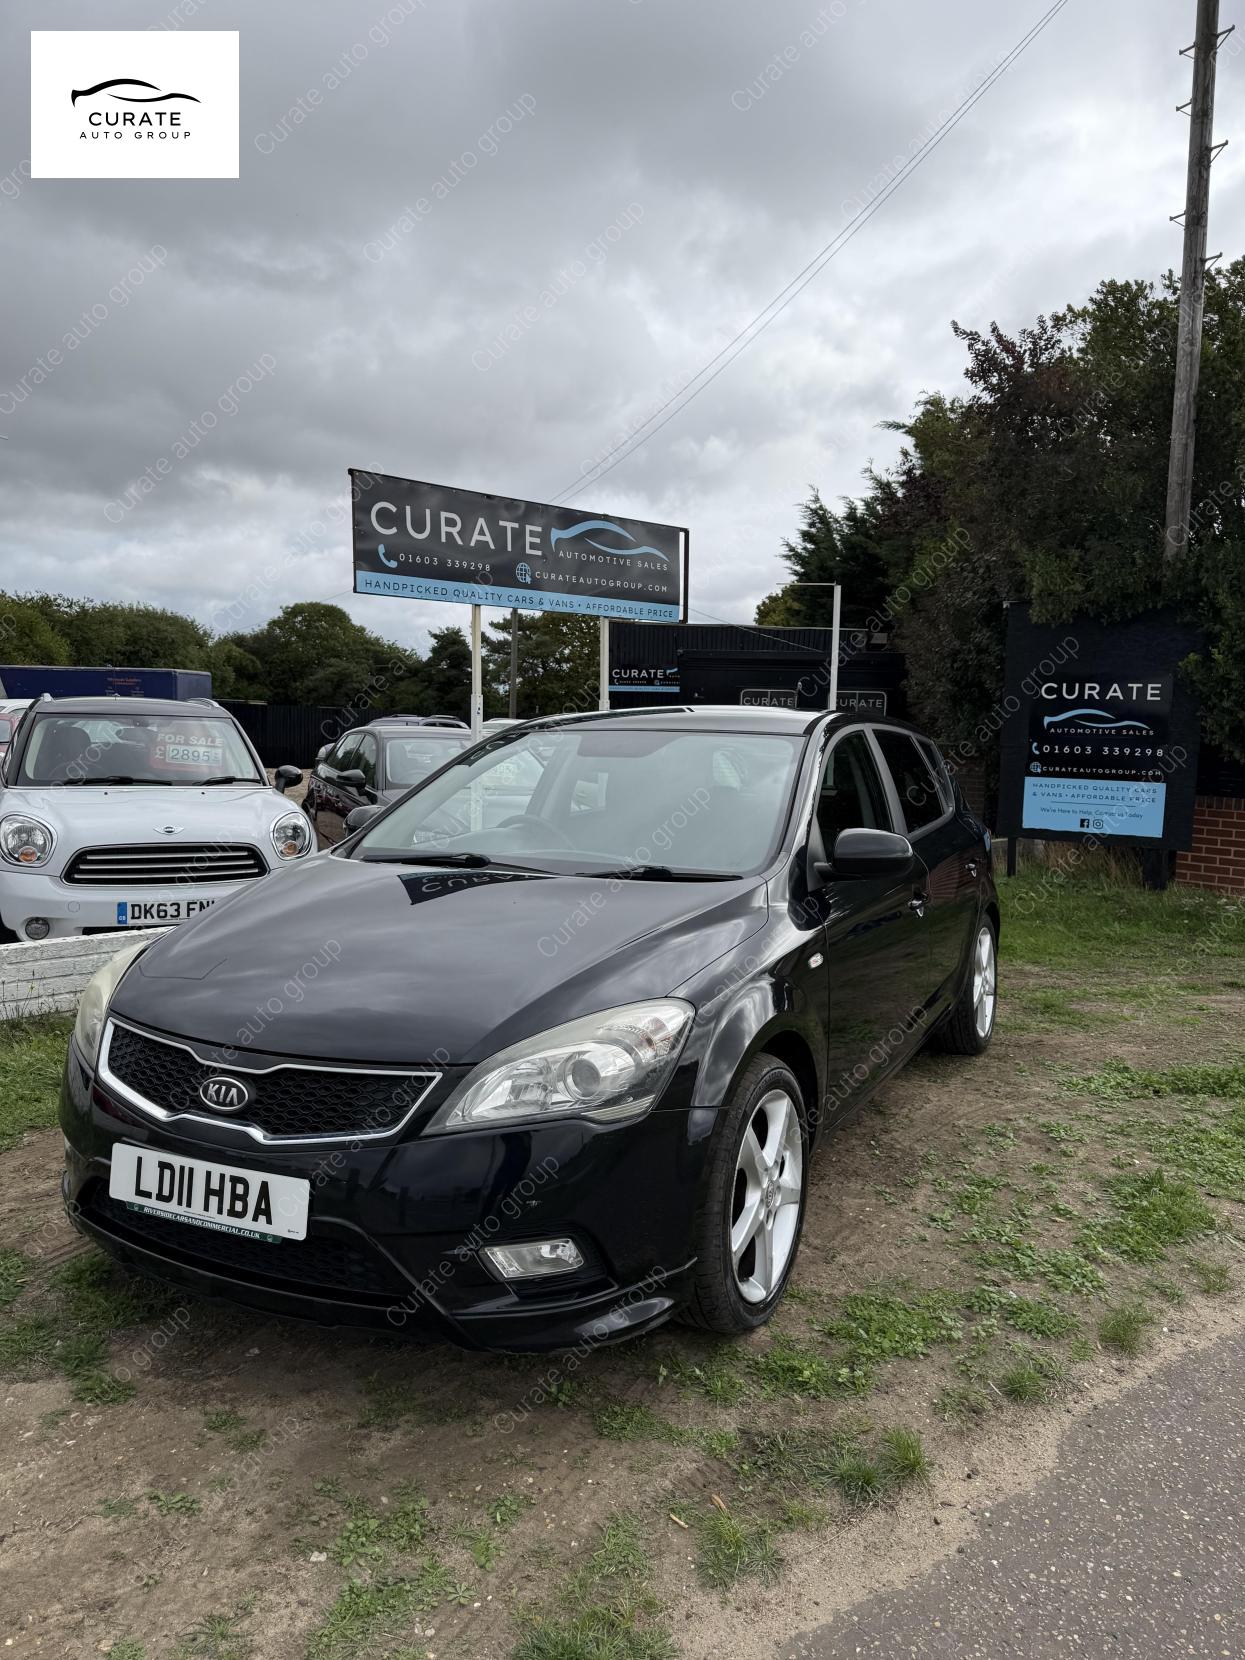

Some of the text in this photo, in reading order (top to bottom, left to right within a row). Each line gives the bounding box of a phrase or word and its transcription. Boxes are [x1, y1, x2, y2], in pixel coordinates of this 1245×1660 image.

[370, 501, 542, 556] CURATE
[399, 553, 492, 572] 01603 339298
[558, 550, 669, 571] AUTOMOTIVE SALES
[535, 571, 668, 593] CURATEAUTOGROUP.COM
[364, 579, 674, 618] HANDPICKED QUALITY CARS & VANS AFFORDABLE PRICE
[612, 669, 665, 679] CURATE
[1040, 682, 1163, 701] CURATE
[743, 696, 794, 707] CURATE
[837, 699, 883, 708] URATE
[156, 733, 225, 747] FOR SALE
[1122, 728, 1155, 736] SALES
[1042, 745, 1163, 757] 01603 339298
[1042, 766, 1162, 776] CURATEAUTOGROUP.COM
[1032, 783, 1089, 791] HANDPICKED
[1070, 793, 1126, 802] AFFORDABLE
[130, 900, 215, 920] DK63 FN
[206, 1082, 239, 1106] KIA
[134, 1155, 273, 1227] LD11 HBA
[143, 1206, 261, 1240] RIVERSIDECARSANDCOMMERCIAL.CO.UK
